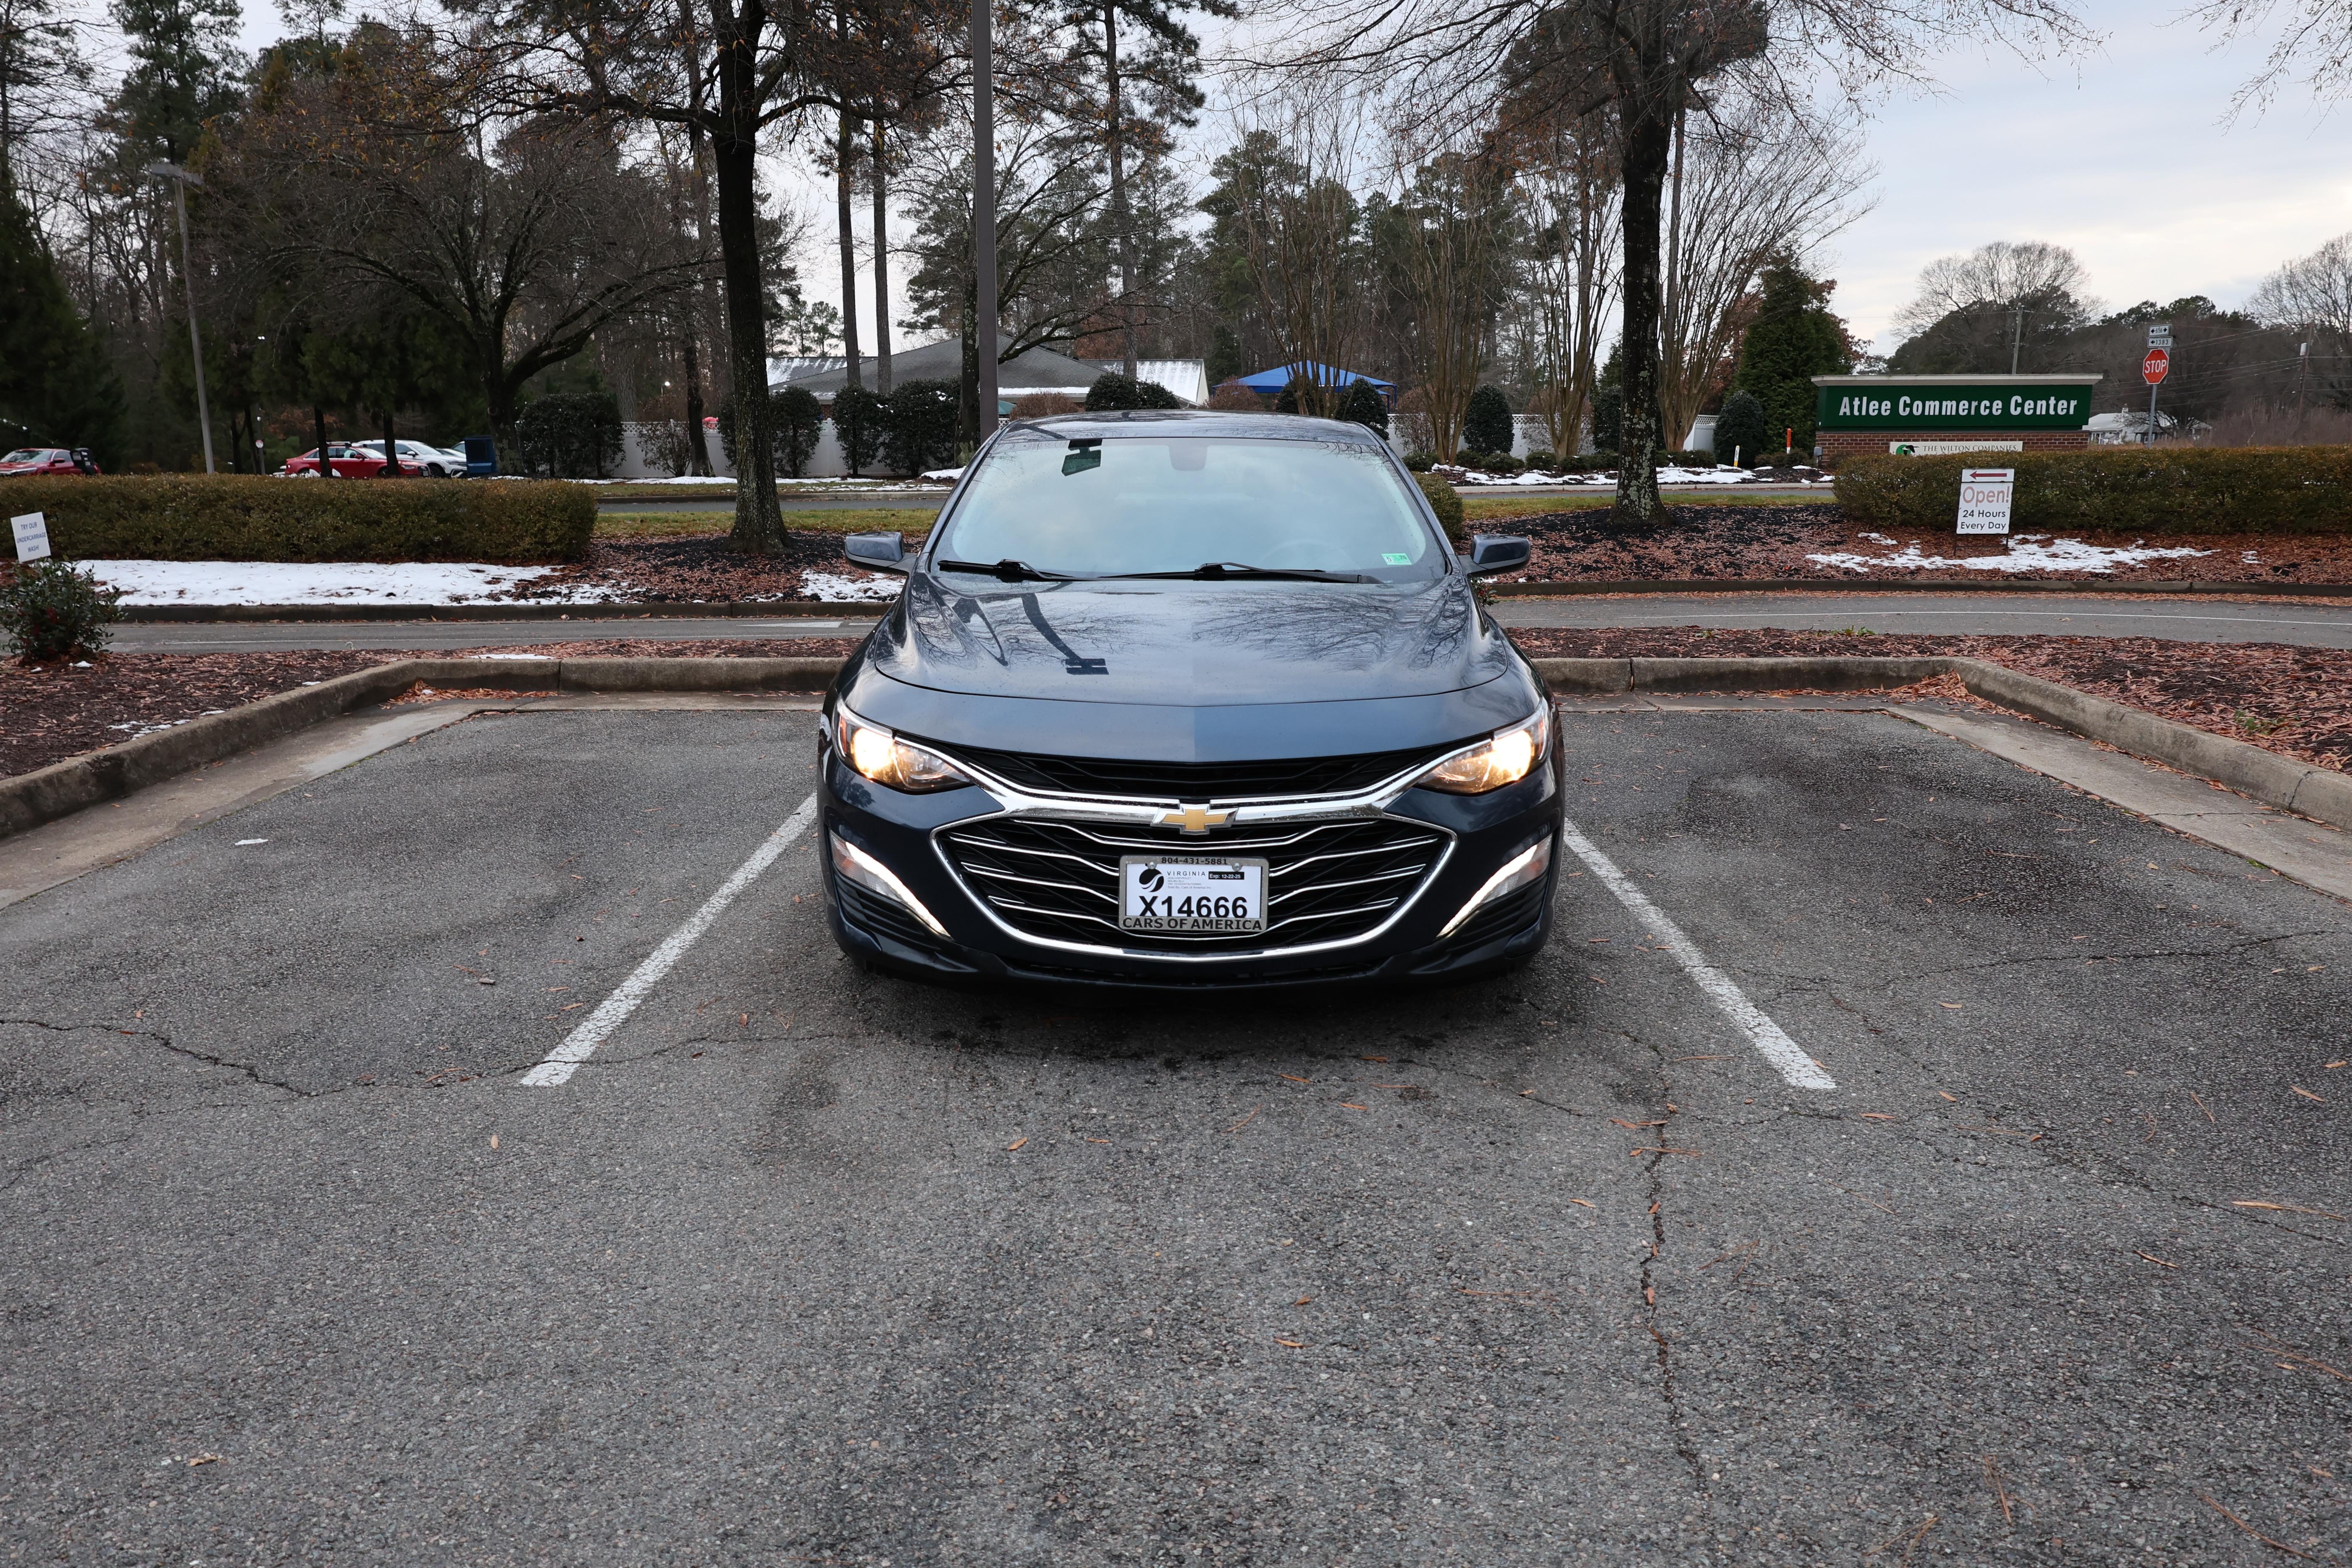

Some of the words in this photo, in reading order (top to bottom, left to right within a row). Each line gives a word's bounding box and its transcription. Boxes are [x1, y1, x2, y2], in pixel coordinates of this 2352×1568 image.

[2145, 360, 2167, 373] STOP
[1839, 396, 1891, 416] Atlee
[1898, 396, 2003, 416] Commerce
[2010, 395, 2077, 415] Center
[1963, 486, 2010, 507] Open!
[1961, 522, 1985, 531] Every
[1988, 522, 2006, 531] Day
[16, 532, 46, 544] UNDERCARRIAGE
[1139, 896, 1247, 919] X14666
[1123, 917, 1163, 928] CARS
[1167, 918, 1188, 929] OF
[1191, 919, 1263, 930] AMERICA
